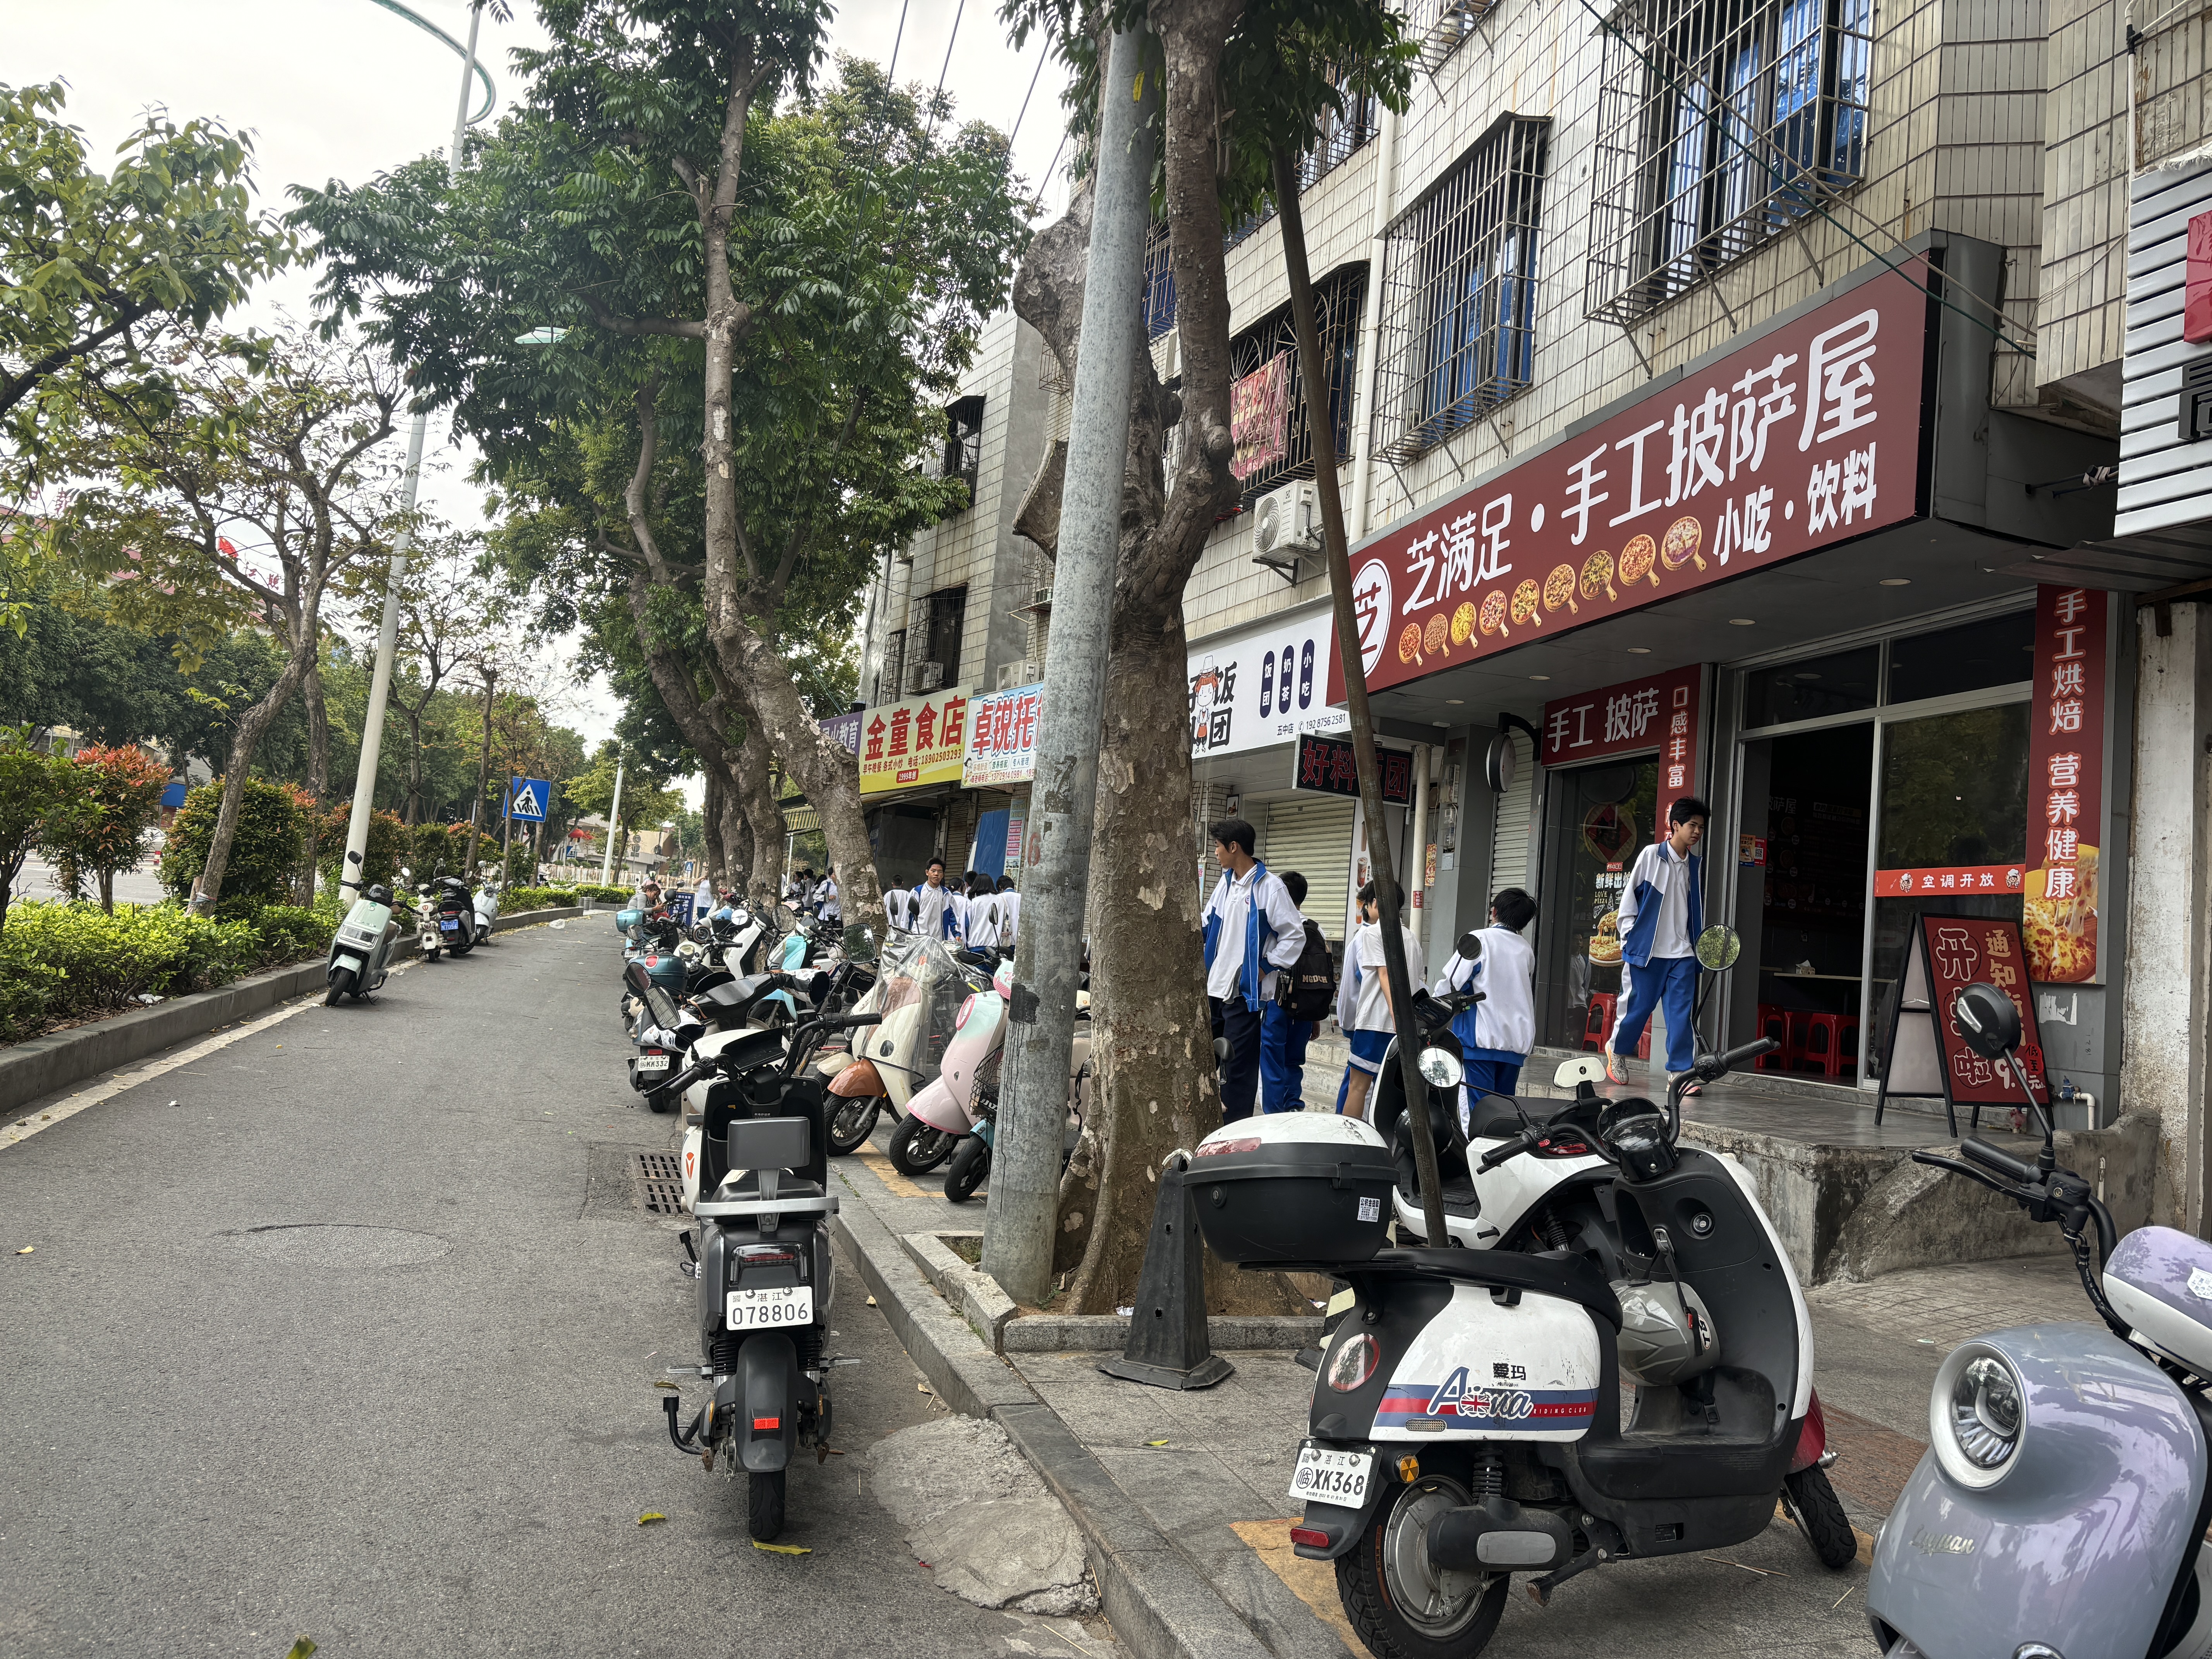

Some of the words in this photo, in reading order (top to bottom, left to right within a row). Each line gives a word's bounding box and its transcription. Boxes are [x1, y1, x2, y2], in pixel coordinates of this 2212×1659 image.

[1281, 658, 1292, 702] 奶茶
[1302, 652, 1312, 696] 小吃
[2051, 589, 2086, 733] 手工烘焙
[1262, 662, 1273, 706] 饭团
[865, 695, 967, 761] 金童食店
[972, 689, 1043, 759] 卓锐托
[1277, 723, 1294, 736] 五中店
[1668, 686, 1688, 788] 口感丰富
[1302, 739, 1409, 800] 好料团
[2045, 754, 2080, 898] 营养健康
[1921, 872, 1995, 889] 空调开放
[1936, 928, 1992, 1085] 开啦
[732, 1303, 808, 1325] 078806
[757, 1292, 783, 1302] 湛江
[1324, 1454, 1345, 1466] 湛江
